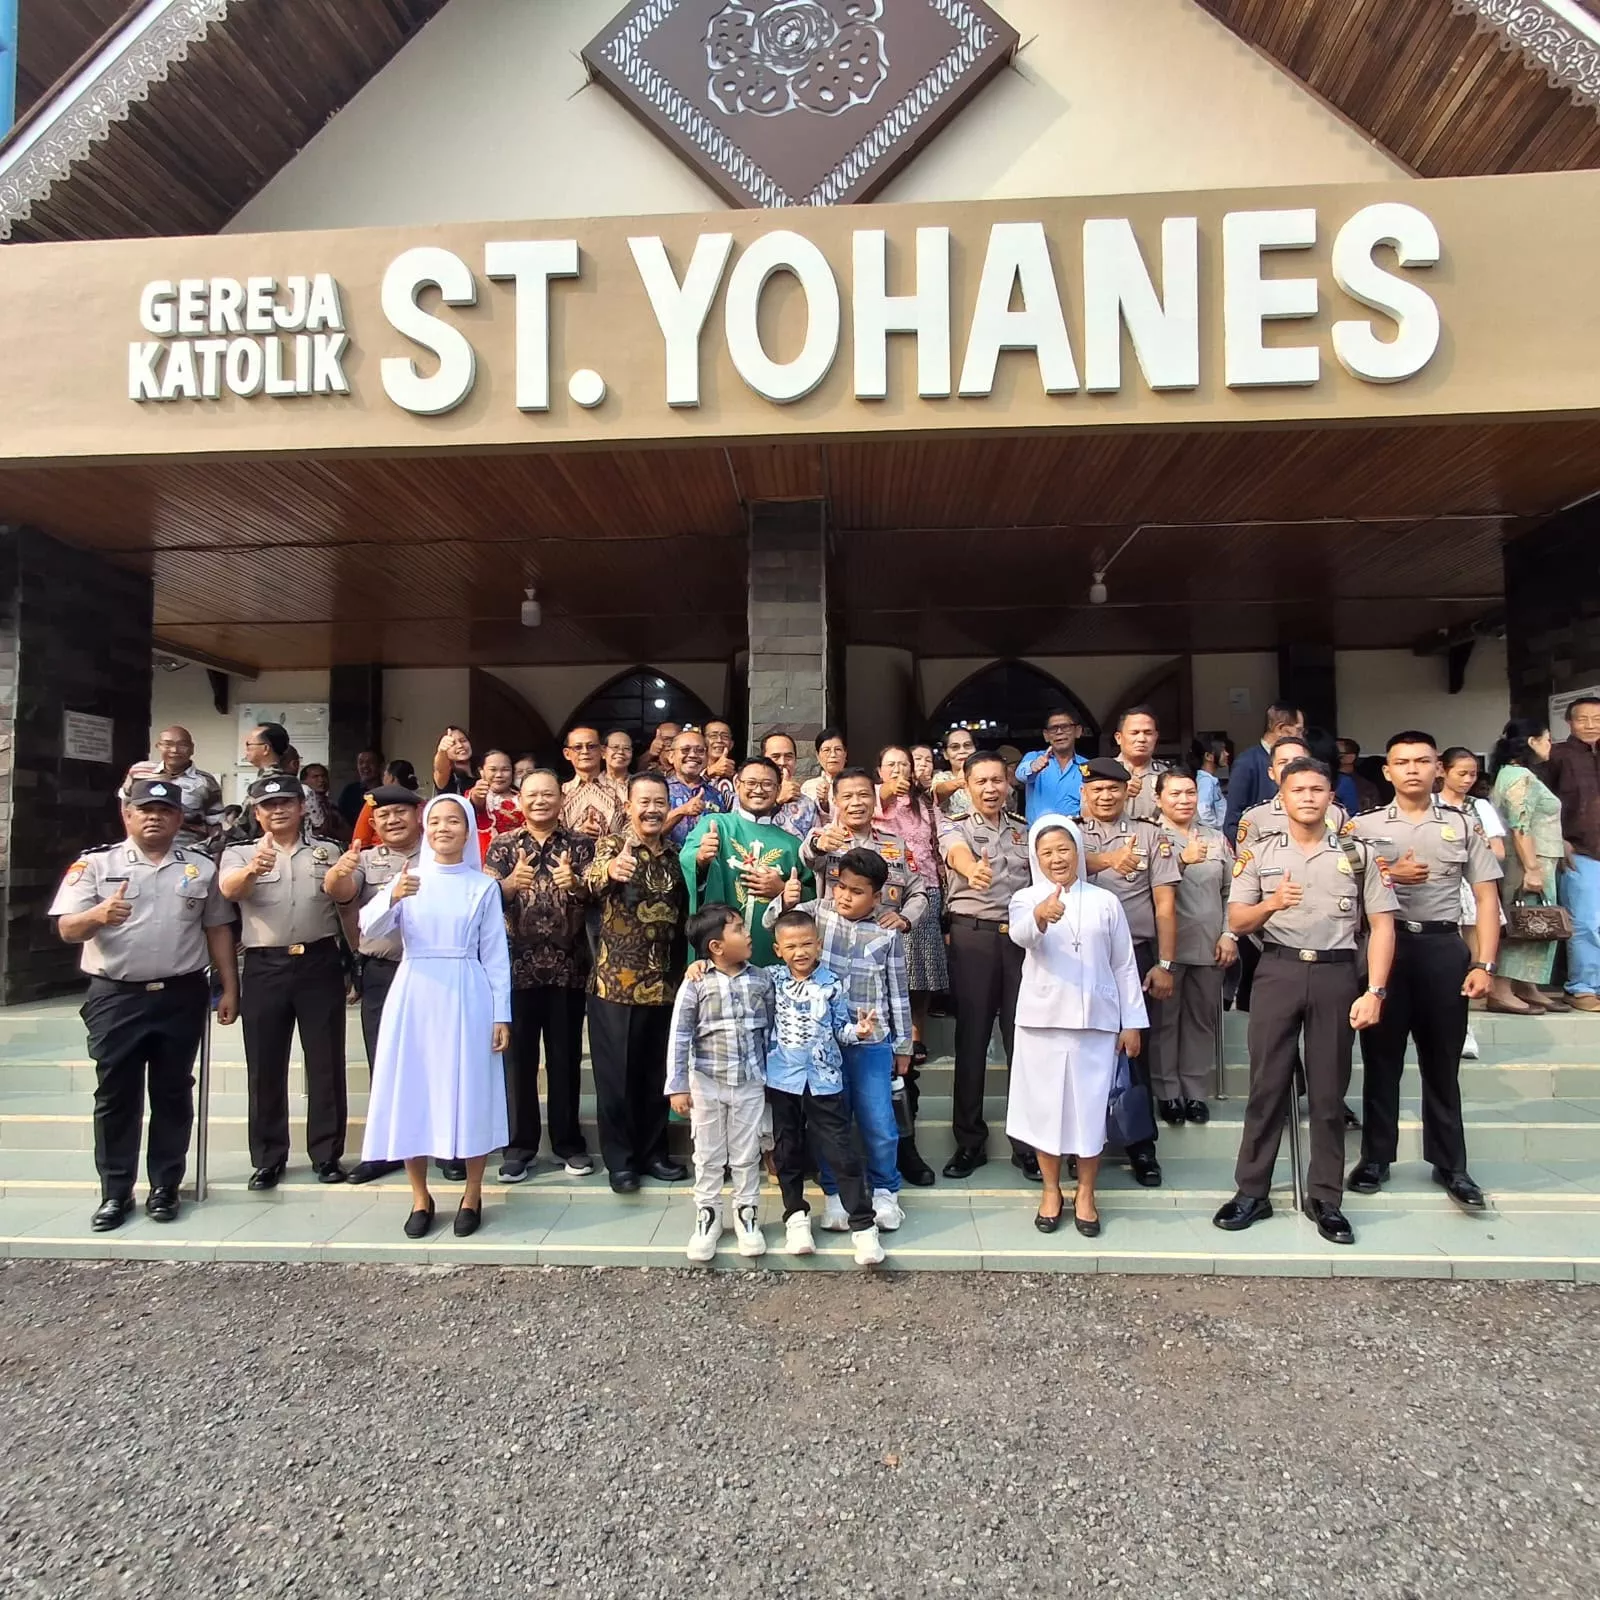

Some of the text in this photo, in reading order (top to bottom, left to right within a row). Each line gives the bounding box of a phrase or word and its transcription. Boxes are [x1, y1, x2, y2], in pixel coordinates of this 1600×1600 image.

[139, 273, 344, 337] GEREJA
[381, 202, 1440, 415] ST. YOHANES
[128, 333, 350, 402] KATOLIK
